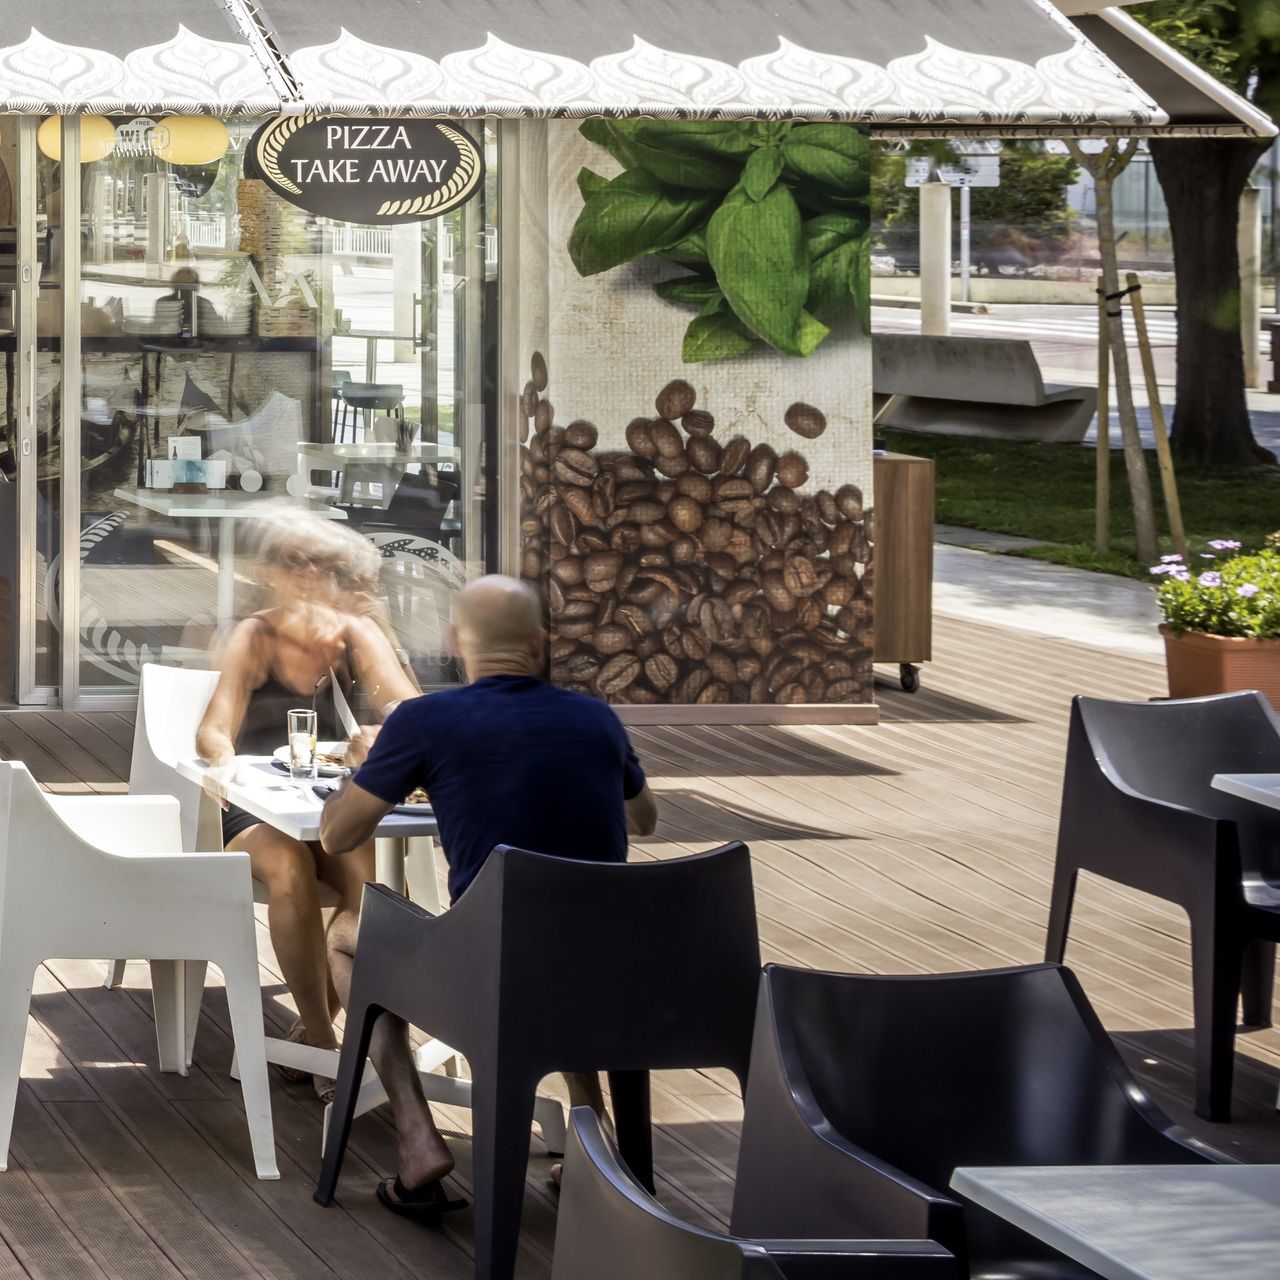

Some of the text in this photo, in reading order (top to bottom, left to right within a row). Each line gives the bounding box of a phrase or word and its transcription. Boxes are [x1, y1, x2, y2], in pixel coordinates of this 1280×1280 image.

[326, 125, 413, 150] PIZZA
[291, 159, 448, 184] TAKE AWAY
